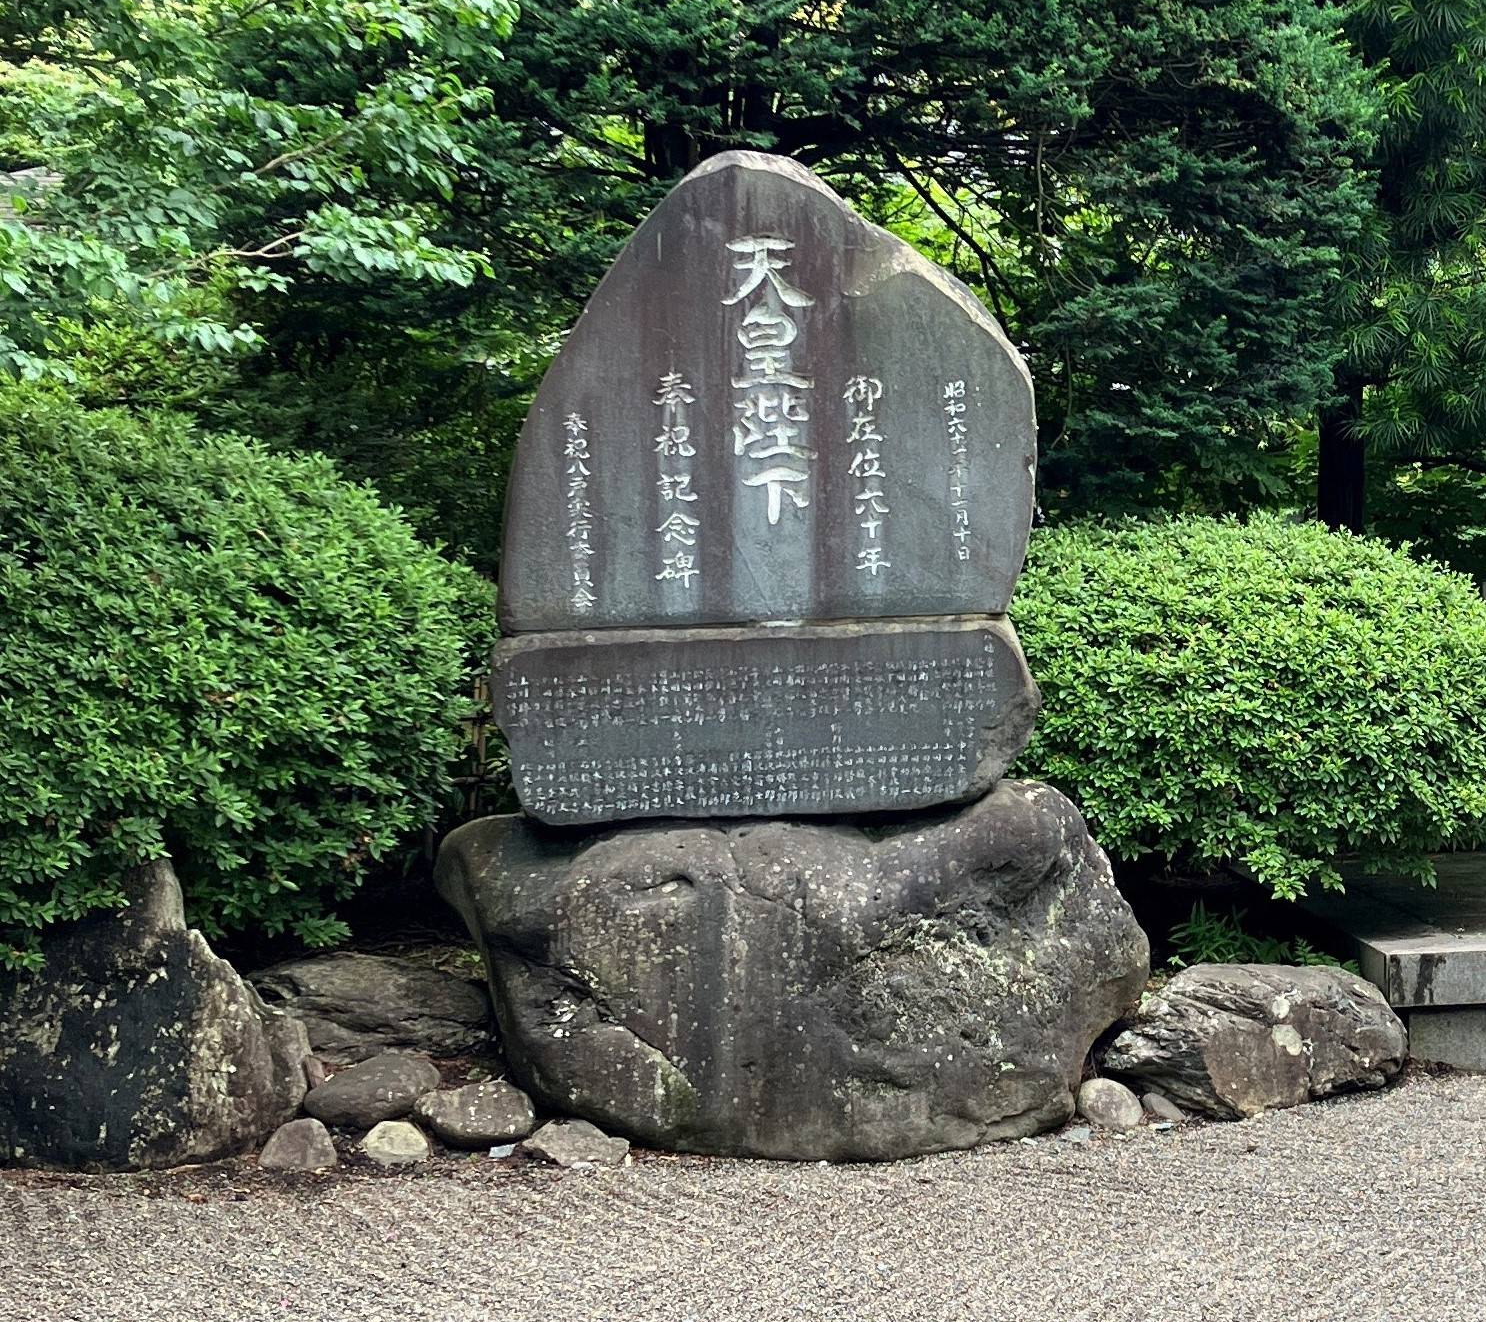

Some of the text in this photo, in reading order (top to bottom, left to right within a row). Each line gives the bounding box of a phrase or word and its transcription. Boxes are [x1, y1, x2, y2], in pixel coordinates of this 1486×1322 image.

[652, 371, 701, 588] 奉祝記念碑
[721, 235, 818, 526] 天皇陛下
[842, 375, 892, 576] 御在位六十年
